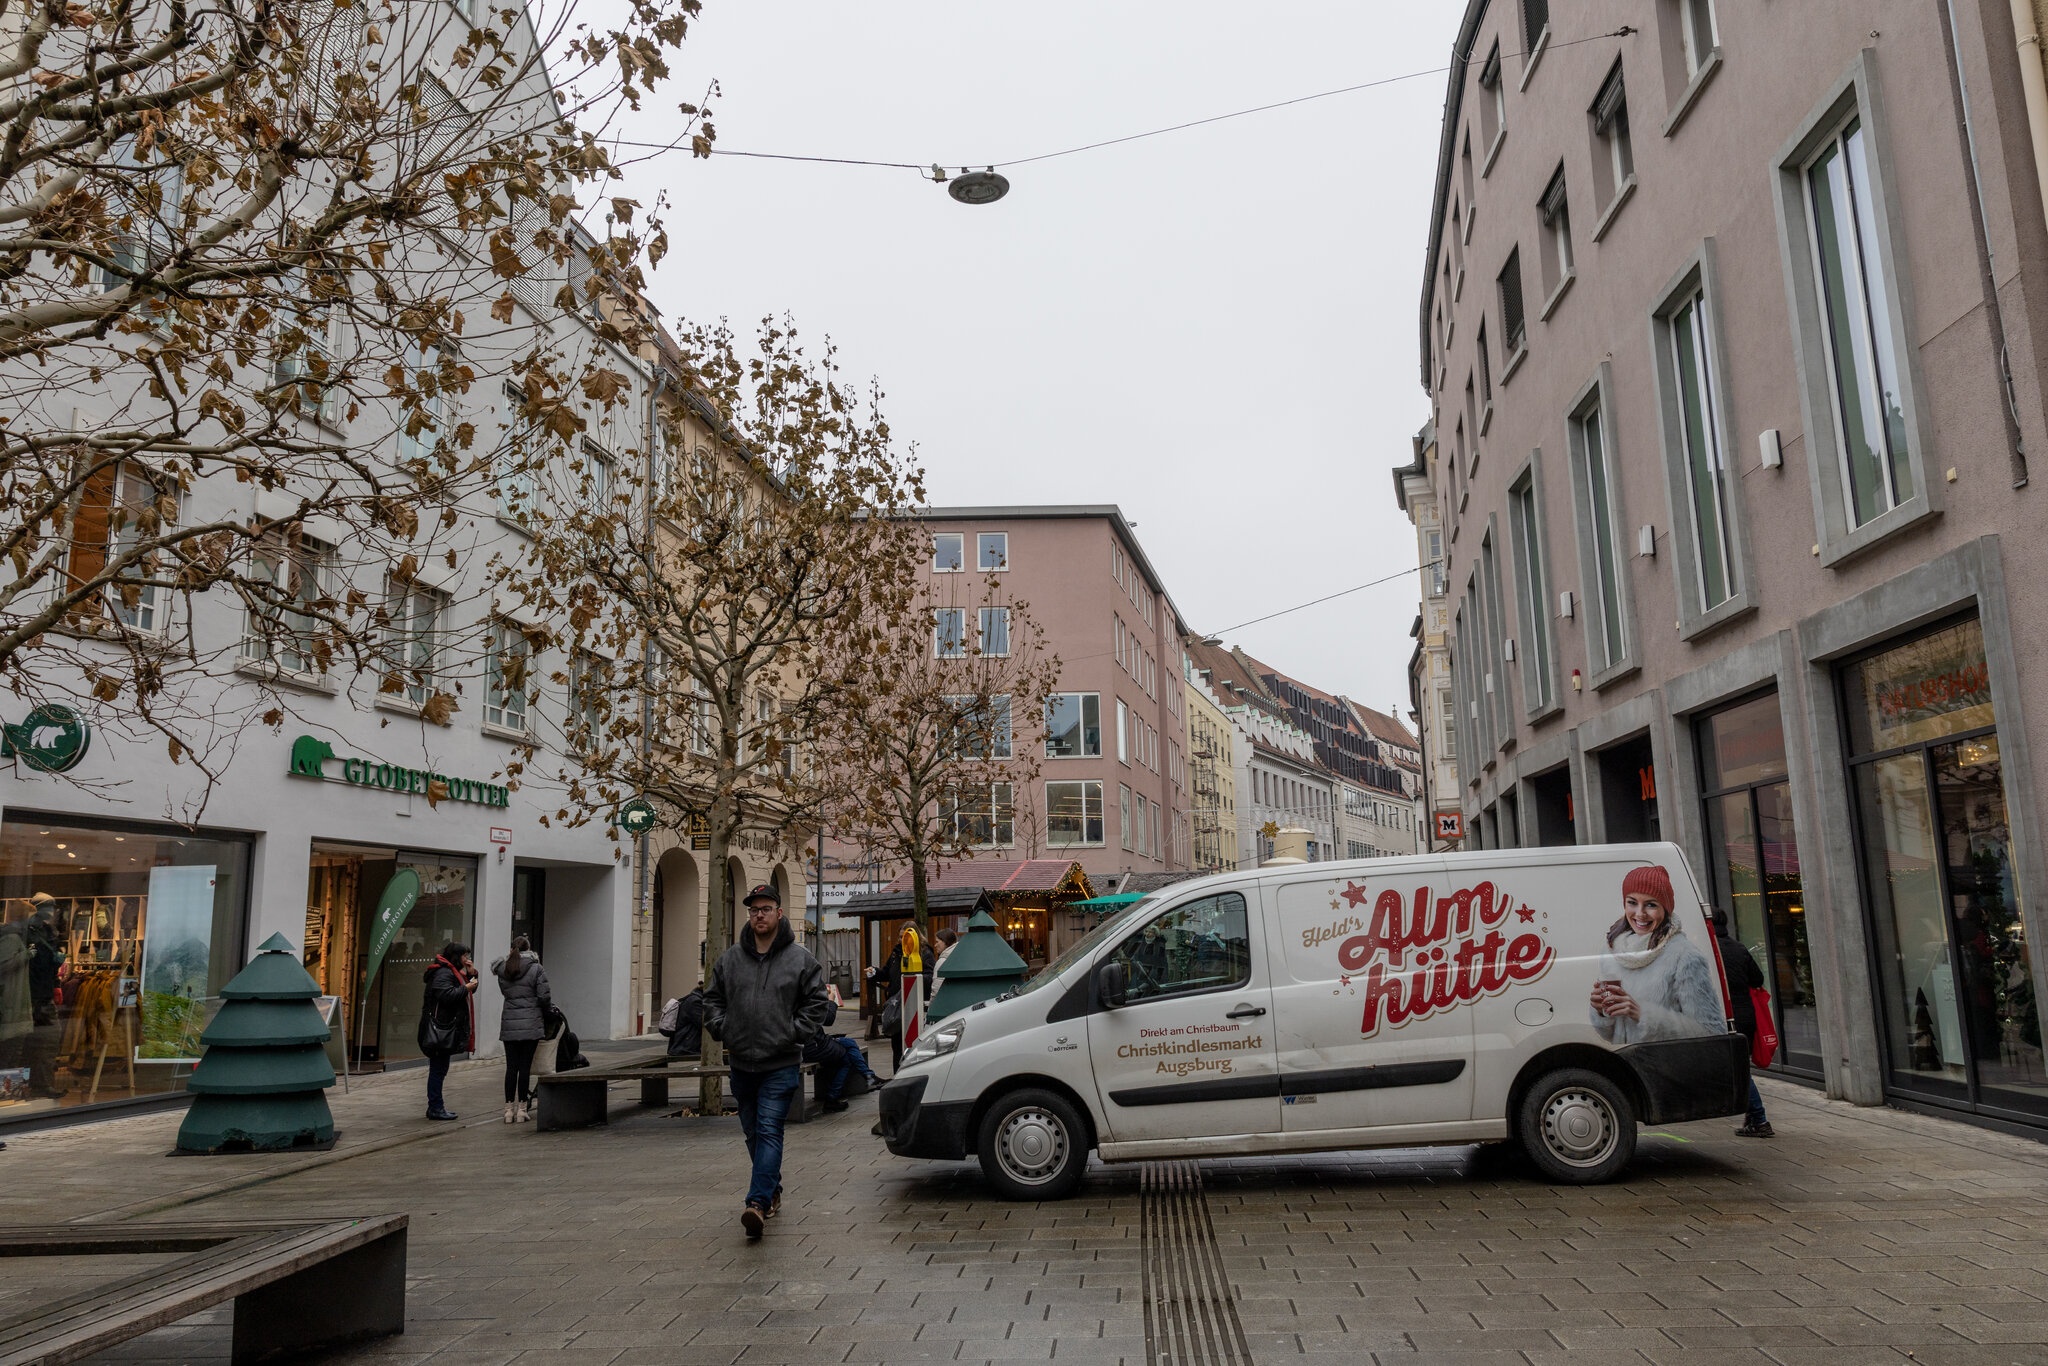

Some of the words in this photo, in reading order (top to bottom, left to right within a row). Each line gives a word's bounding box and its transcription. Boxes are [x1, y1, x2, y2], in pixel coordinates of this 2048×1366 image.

[1442, 819, 1456, 831] M
[374, 892, 414, 956] GLOBETROTTER
[1338, 881, 1511, 973] Alm
[1361, 930, 1555, 1037] hütte
[1140, 1027, 1168, 1038] Direkt
[1169, 1028, 1184, 1036] am
[1186, 1023, 1240, 1035] Christbaum
[1117, 1035, 1263, 1058] Christkindlesmarkt
[1155, 1057, 1232, 1077] Augsburg
